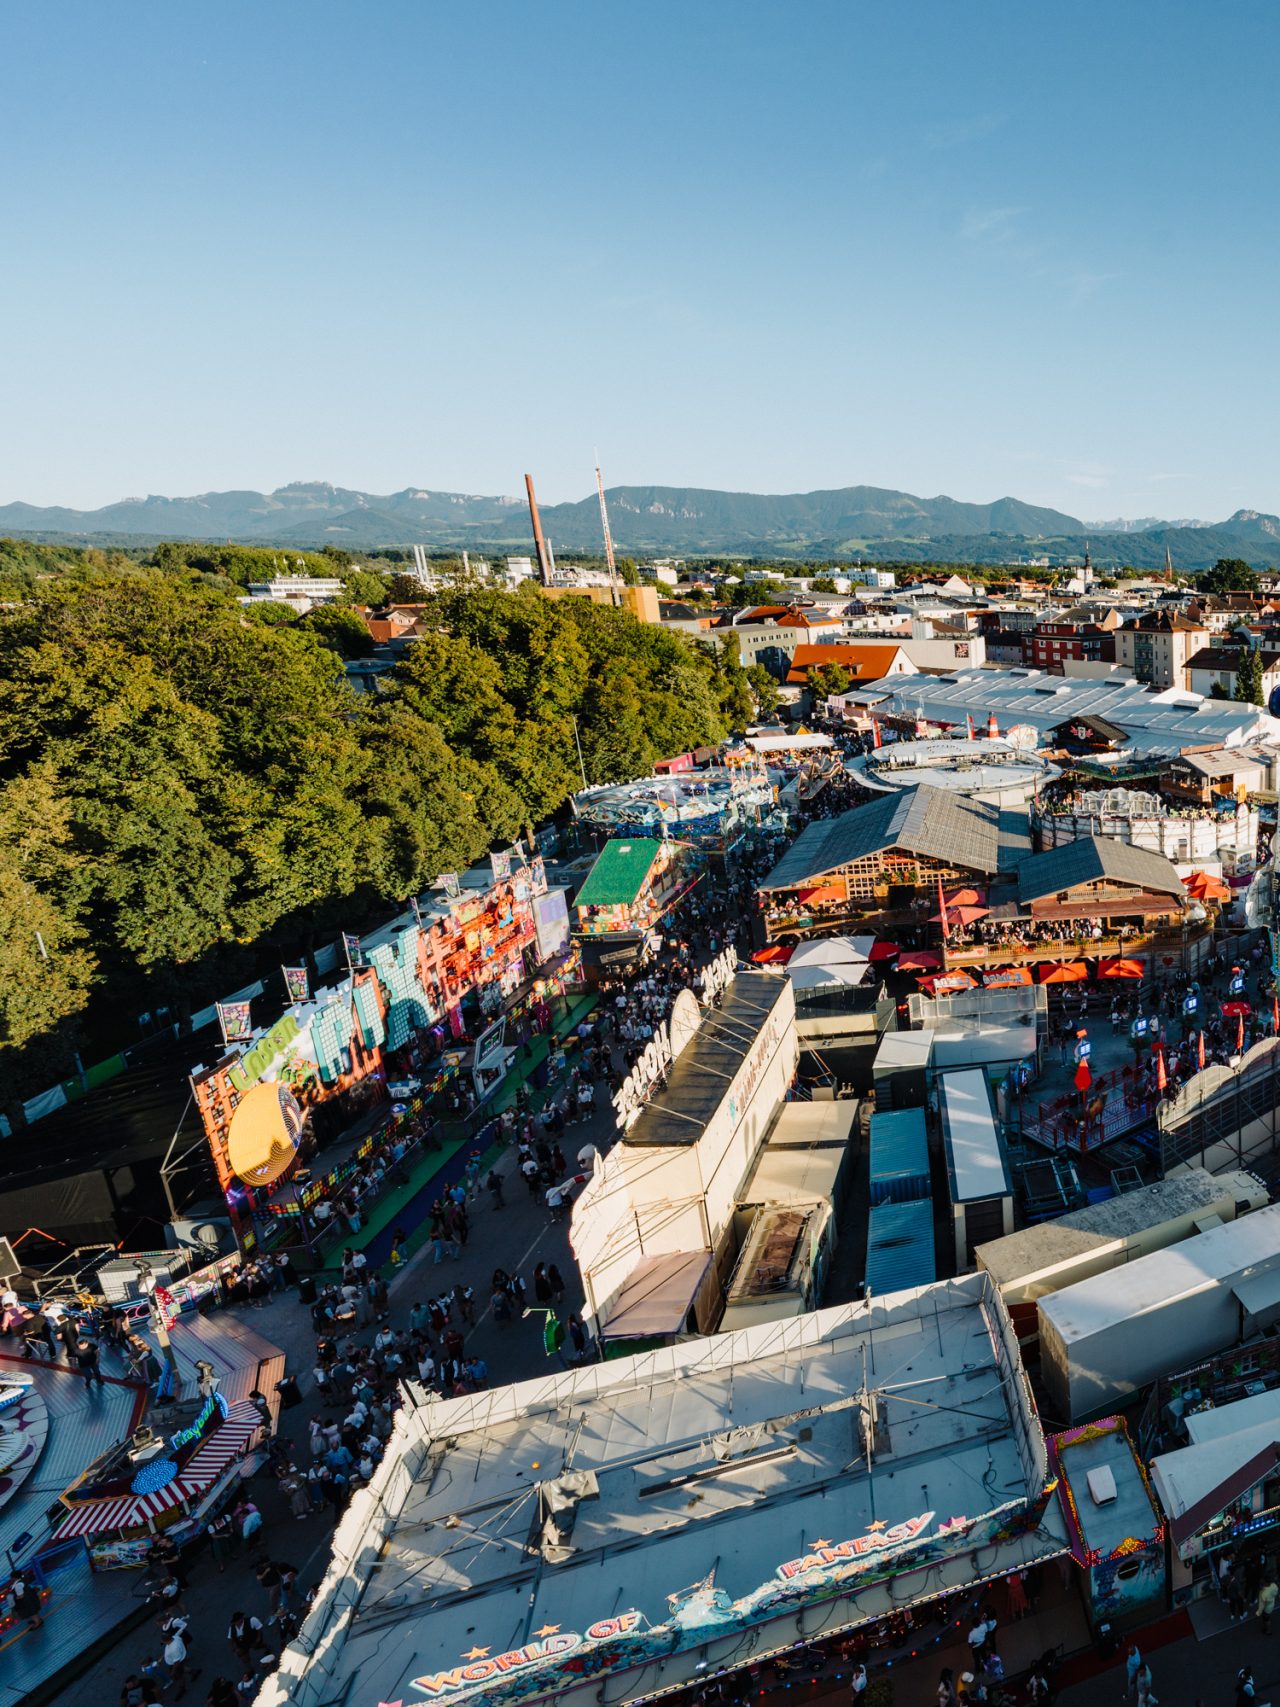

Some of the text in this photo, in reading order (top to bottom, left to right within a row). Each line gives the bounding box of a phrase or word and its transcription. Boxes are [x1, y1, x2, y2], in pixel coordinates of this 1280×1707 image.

[228, 1015, 300, 1091] LASER
[413, 1511, 935, 1694] WORLD OF FANTASY
